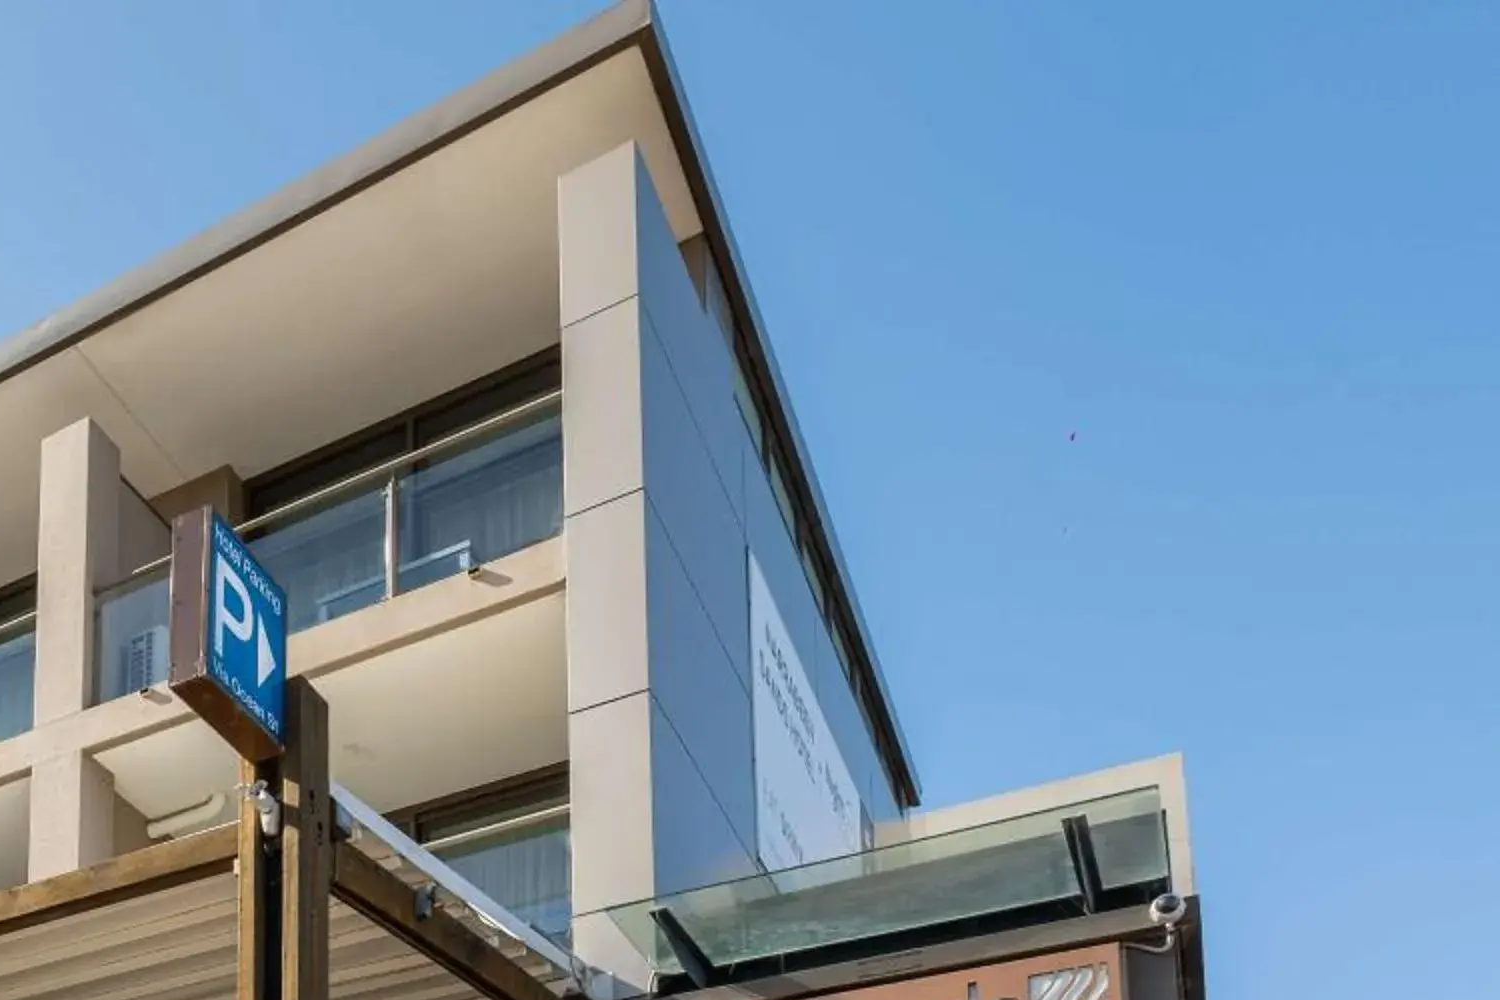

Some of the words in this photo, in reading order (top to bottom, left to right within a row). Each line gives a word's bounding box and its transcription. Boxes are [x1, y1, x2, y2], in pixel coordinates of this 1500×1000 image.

[214, 520, 241, 567] Hotel
[243, 557, 281, 616] Parking
[215, 552, 253, 656] P
[213, 655, 229, 686] Via
[231, 676, 265, 720] Ocean
[267, 711, 279, 735] St
